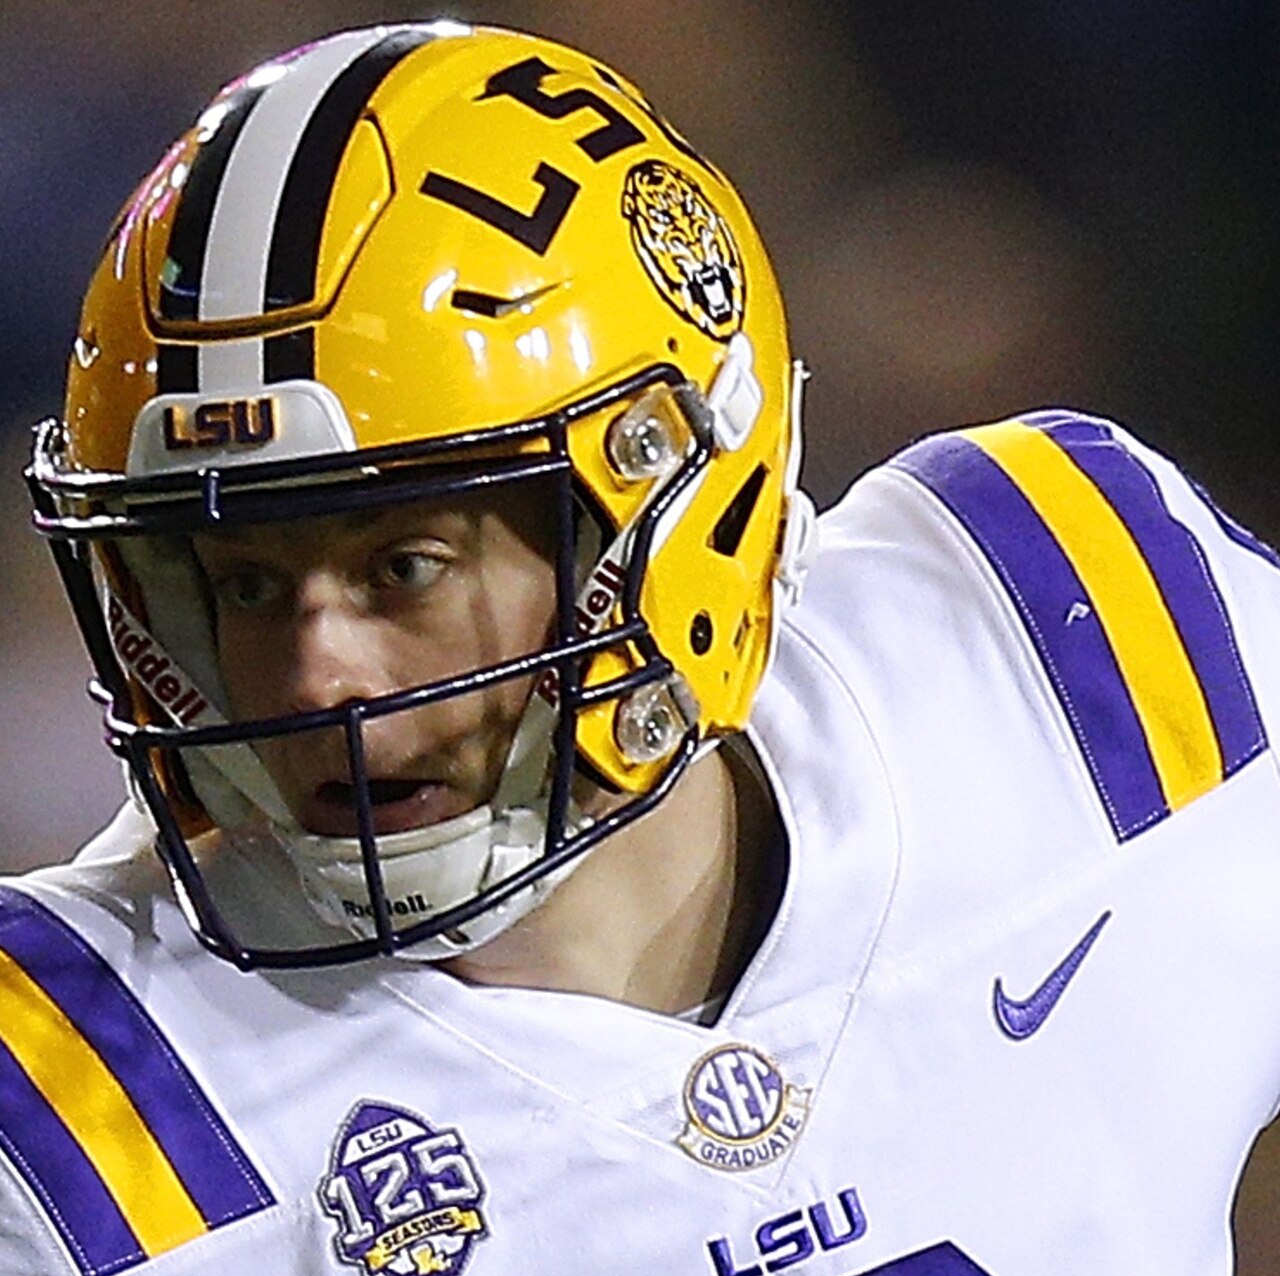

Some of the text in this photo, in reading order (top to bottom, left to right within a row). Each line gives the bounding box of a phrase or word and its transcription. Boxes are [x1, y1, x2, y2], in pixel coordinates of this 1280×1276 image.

[419, 55, 656, 257] LS
[163, 398, 279, 450] LSU
[536, 558, 628, 708] Rdell
[694, 1050, 783, 1139] SEC
[355, 1122, 404, 1153] LSU
[699, 1113, 802, 1168] GRADUATE
[326, 1132, 481, 1245] 125
[381, 1211, 456, 1251] SEASONS
